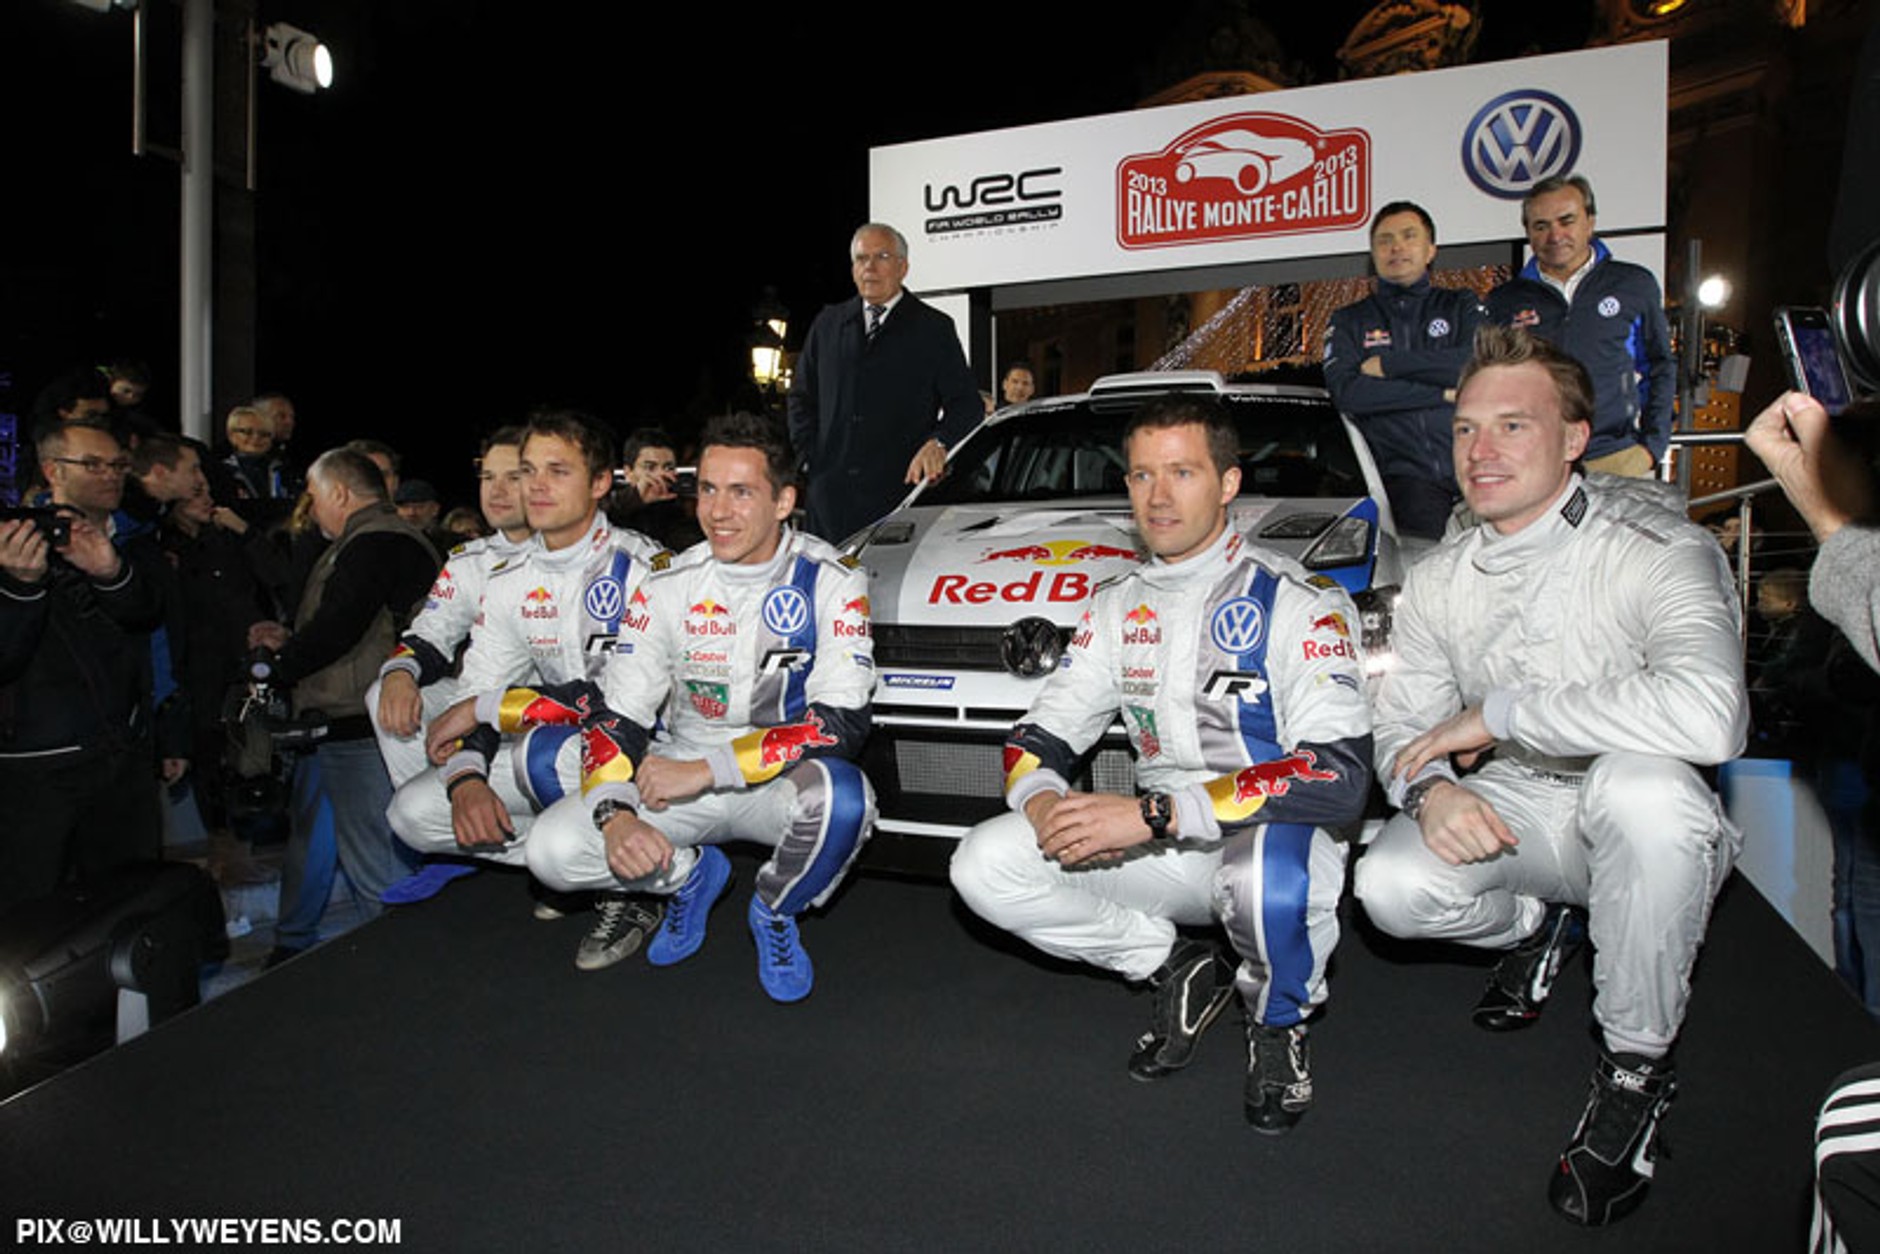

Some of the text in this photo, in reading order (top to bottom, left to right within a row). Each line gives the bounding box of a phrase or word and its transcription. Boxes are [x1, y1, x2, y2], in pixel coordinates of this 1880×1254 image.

[1314, 145, 1358, 181] 2013
[925, 167, 1062, 212] WRC
[1127, 170, 1167, 196] 2013
[1127, 165, 1358, 237] RALLYE MONTE-CARLO
[951, 214, 1004, 228] WORLD
[1007, 208, 1059, 221] RALLY
[928, 571, 1044, 604] Red
[710, 619, 737, 635] Bull
[767, 591, 805, 631] VW
[1216, 600, 1261, 648] VW
[834, 620, 867, 637] Red
[760, 650, 811, 675] R
[1303, 640, 1346, 661] Red
[1203, 671, 1267, 704] R
